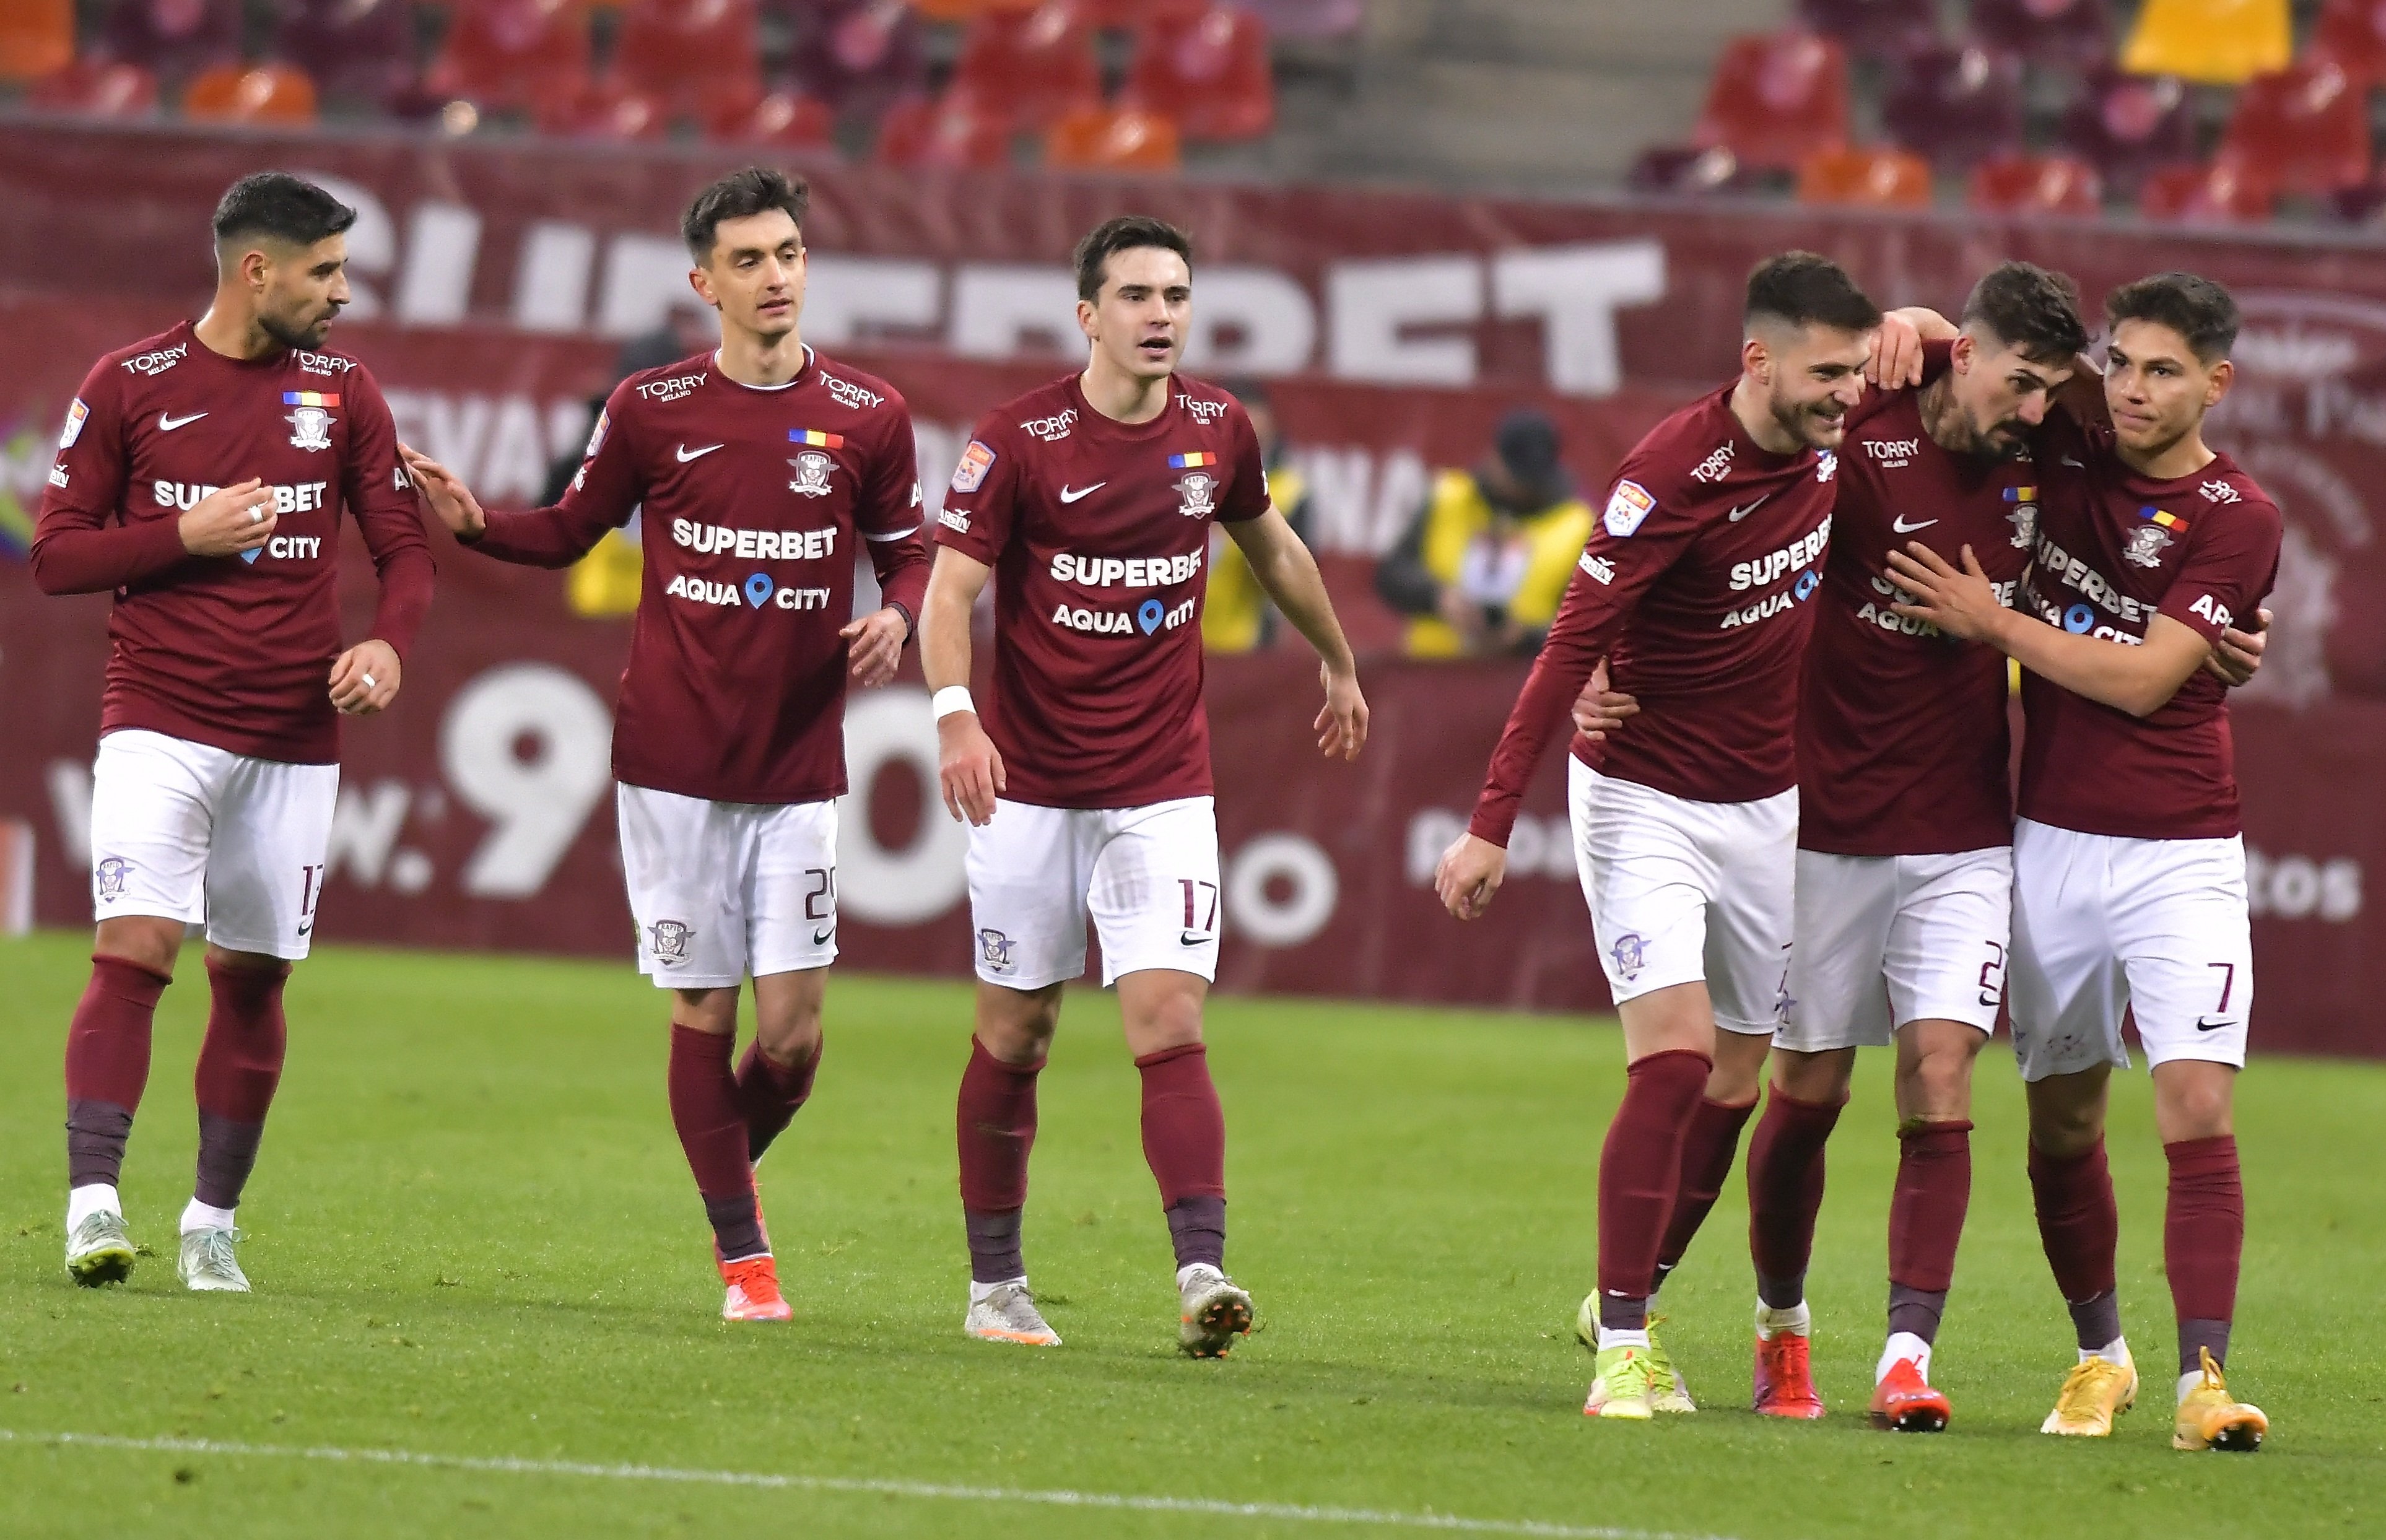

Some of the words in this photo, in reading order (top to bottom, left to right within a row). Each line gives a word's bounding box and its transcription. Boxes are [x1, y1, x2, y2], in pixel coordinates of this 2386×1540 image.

[121, 342, 188, 374] TORRY
[147, 360, 177, 376] MILANO
[302, 365, 332, 376] MILANO
[637, 373, 707, 400] TORRY
[661, 389, 691, 402] MILANO
[820, 371, 885, 409] TORRY
[832, 393, 860, 409] MILANO
[1021, 409, 1078, 437] TORRY
[1043, 429, 1071, 442] MILANO
[1691, 440, 1735, 483] TORRY
[1861, 437, 1919, 459] TORRY
[155, 481, 327, 514] SUBET
[269, 537, 321, 559] CITY
[673, 518, 838, 559] SUPERBET
[667, 575, 741, 607] AQUA
[776, 587, 830, 610] CITY
[1053, 604, 1134, 635] AQUA
[1720, 591, 1795, 629] AQUA
[1178, 879, 1217, 932] 17
[2208, 963, 2234, 1013] 7
